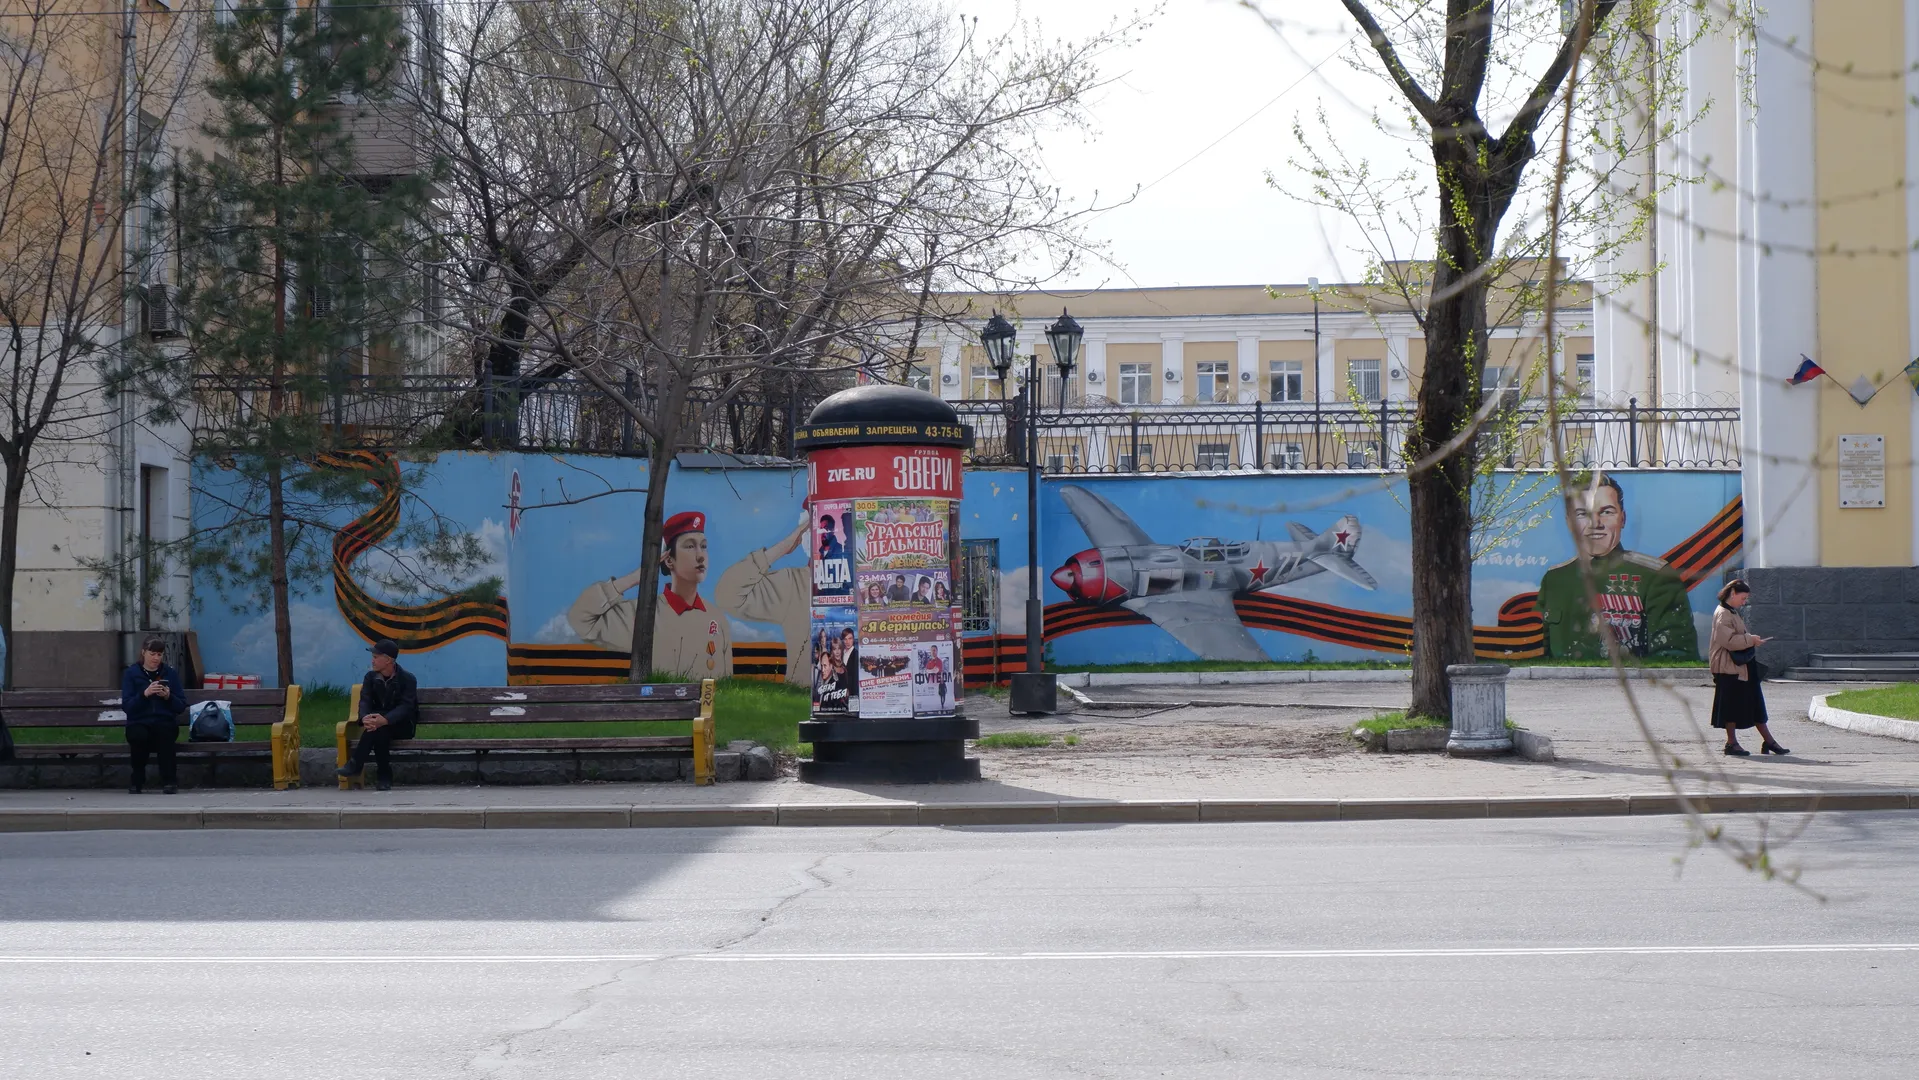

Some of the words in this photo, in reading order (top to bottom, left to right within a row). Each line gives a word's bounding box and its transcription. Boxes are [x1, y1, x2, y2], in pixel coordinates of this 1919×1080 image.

[812, 425, 860, 437] ОБЪЯВЛЕНИЙ
[866, 426, 917, 436] ЗАПРЕЩЕНА
[925, 426, 963, 439] 43-75-61
[828, 467, 875, 482] ZVE.RU
[893, 456, 953, 491] ЗВЕРИ
[867, 522, 942, 539] УРАЛЬСКИЕ
[867, 538, 942, 559] ПЕЛЬМЕНИ
[889, 612, 932, 621] комедия
[880, 619, 949, 633] вернулась!»
[861, 679, 876, 687] ВНЕ
[876, 673, 910, 684] ВРЕМЕНИ
[830, 688, 848, 700] ТЕБЯ
